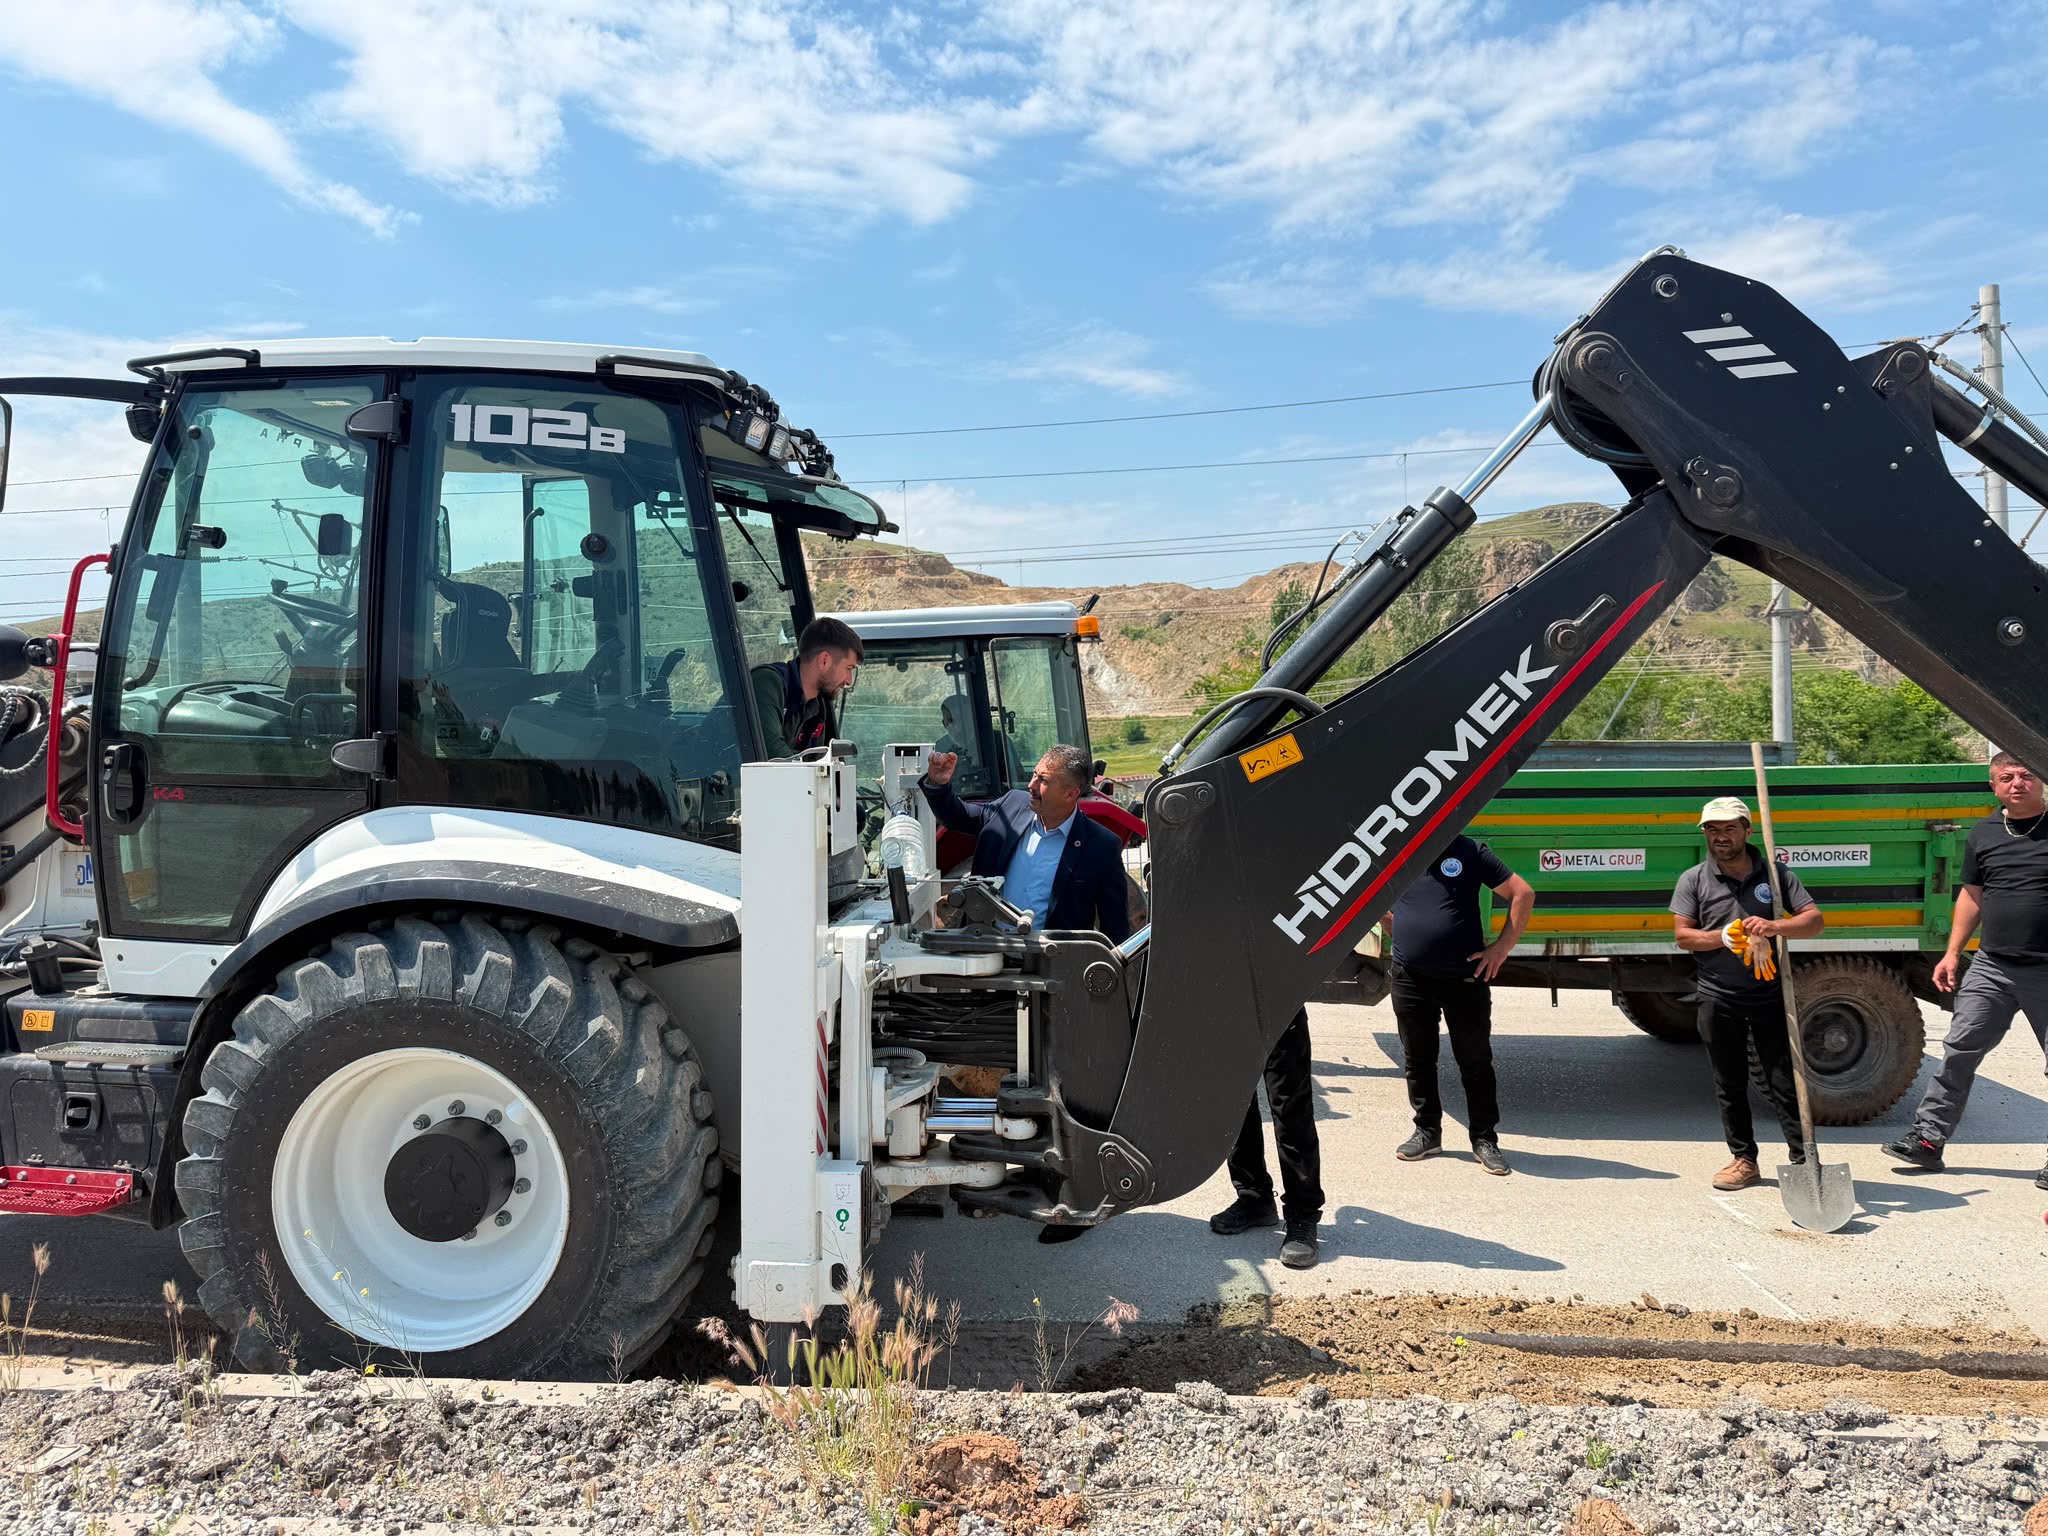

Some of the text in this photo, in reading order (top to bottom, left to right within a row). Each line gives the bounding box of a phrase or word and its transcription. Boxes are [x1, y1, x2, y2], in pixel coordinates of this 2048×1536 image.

[451, 404, 626, 454] 102B
[154, 787, 185, 801] K4
[1565, 854, 1606, 866] METAL
[1609, 854, 1643, 866] GRUP
[1792, 849, 1868, 863] RÖMORKER
